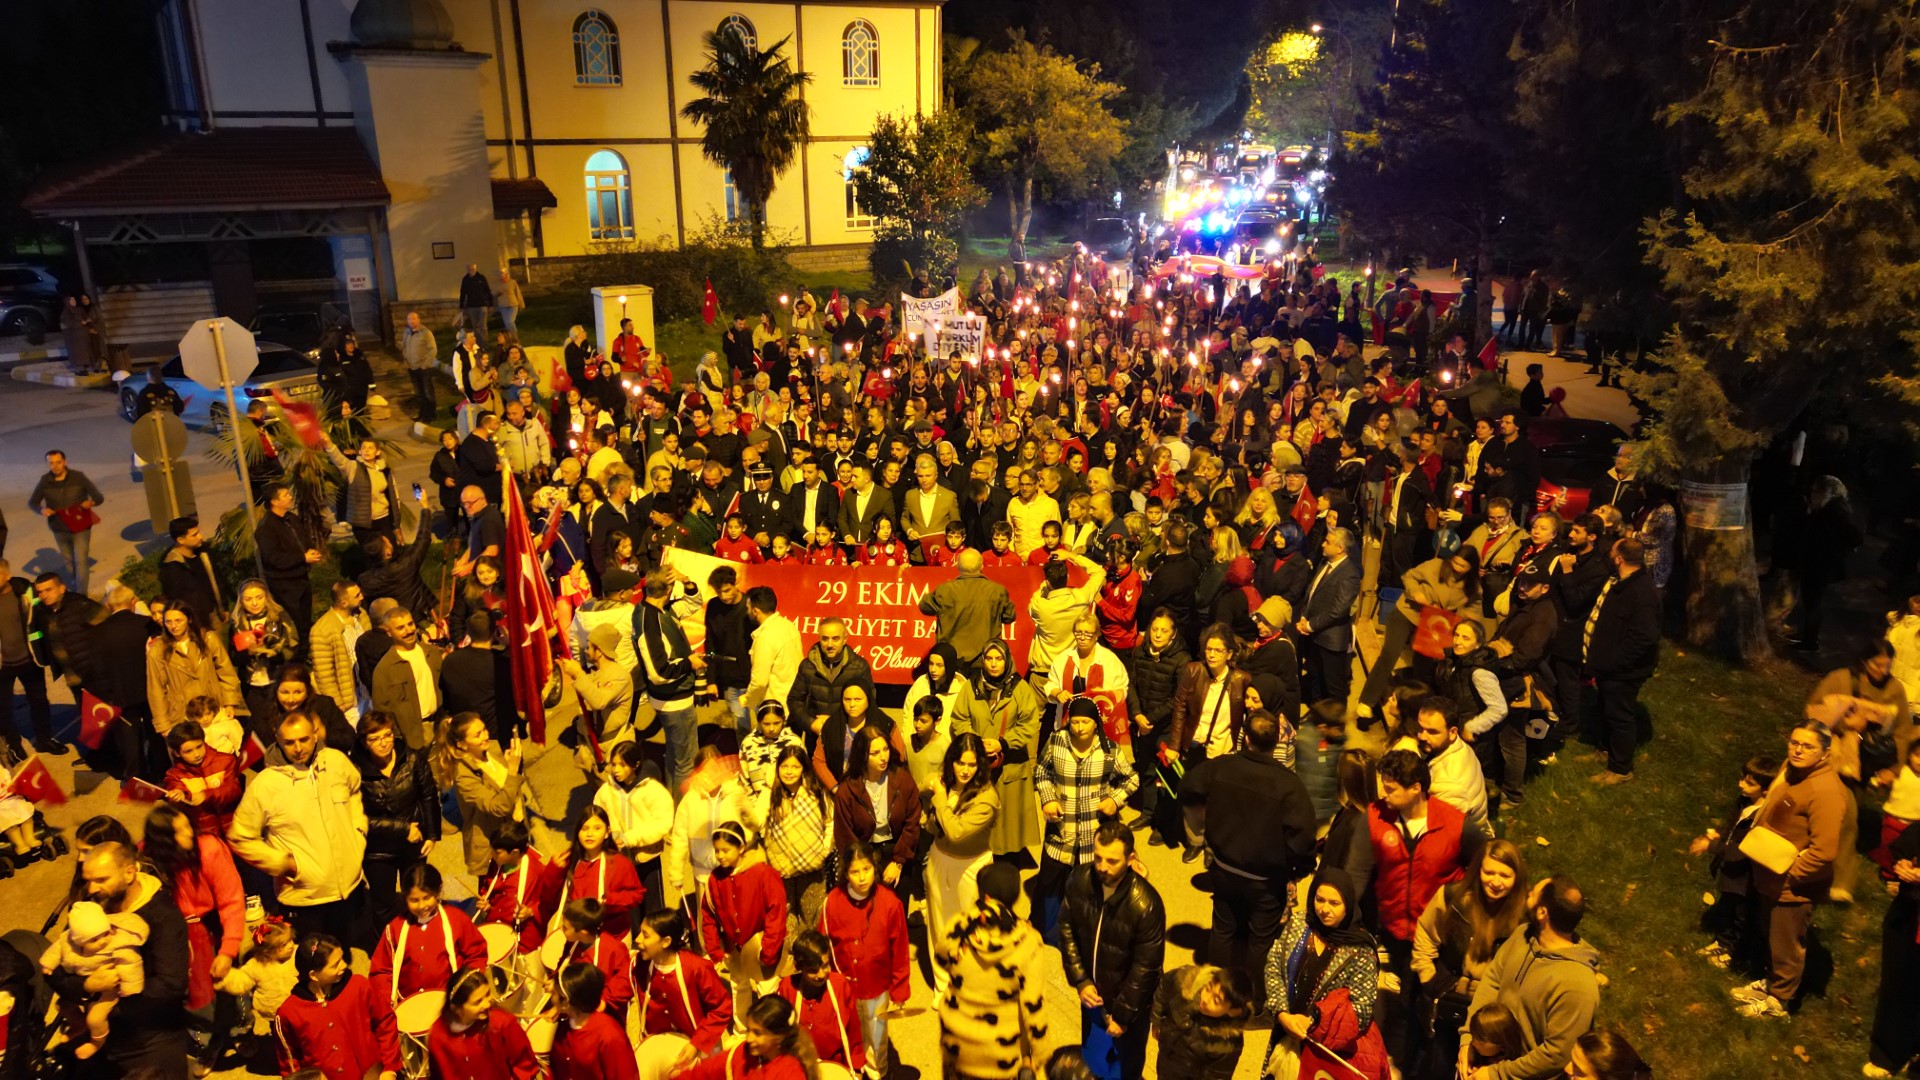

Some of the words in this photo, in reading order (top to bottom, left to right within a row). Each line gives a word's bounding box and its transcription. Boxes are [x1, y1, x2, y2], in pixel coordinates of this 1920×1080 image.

[816, 581, 848, 605] 29
[857, 577, 930, 607] EKİM
[869, 644, 922, 671] Olsun
